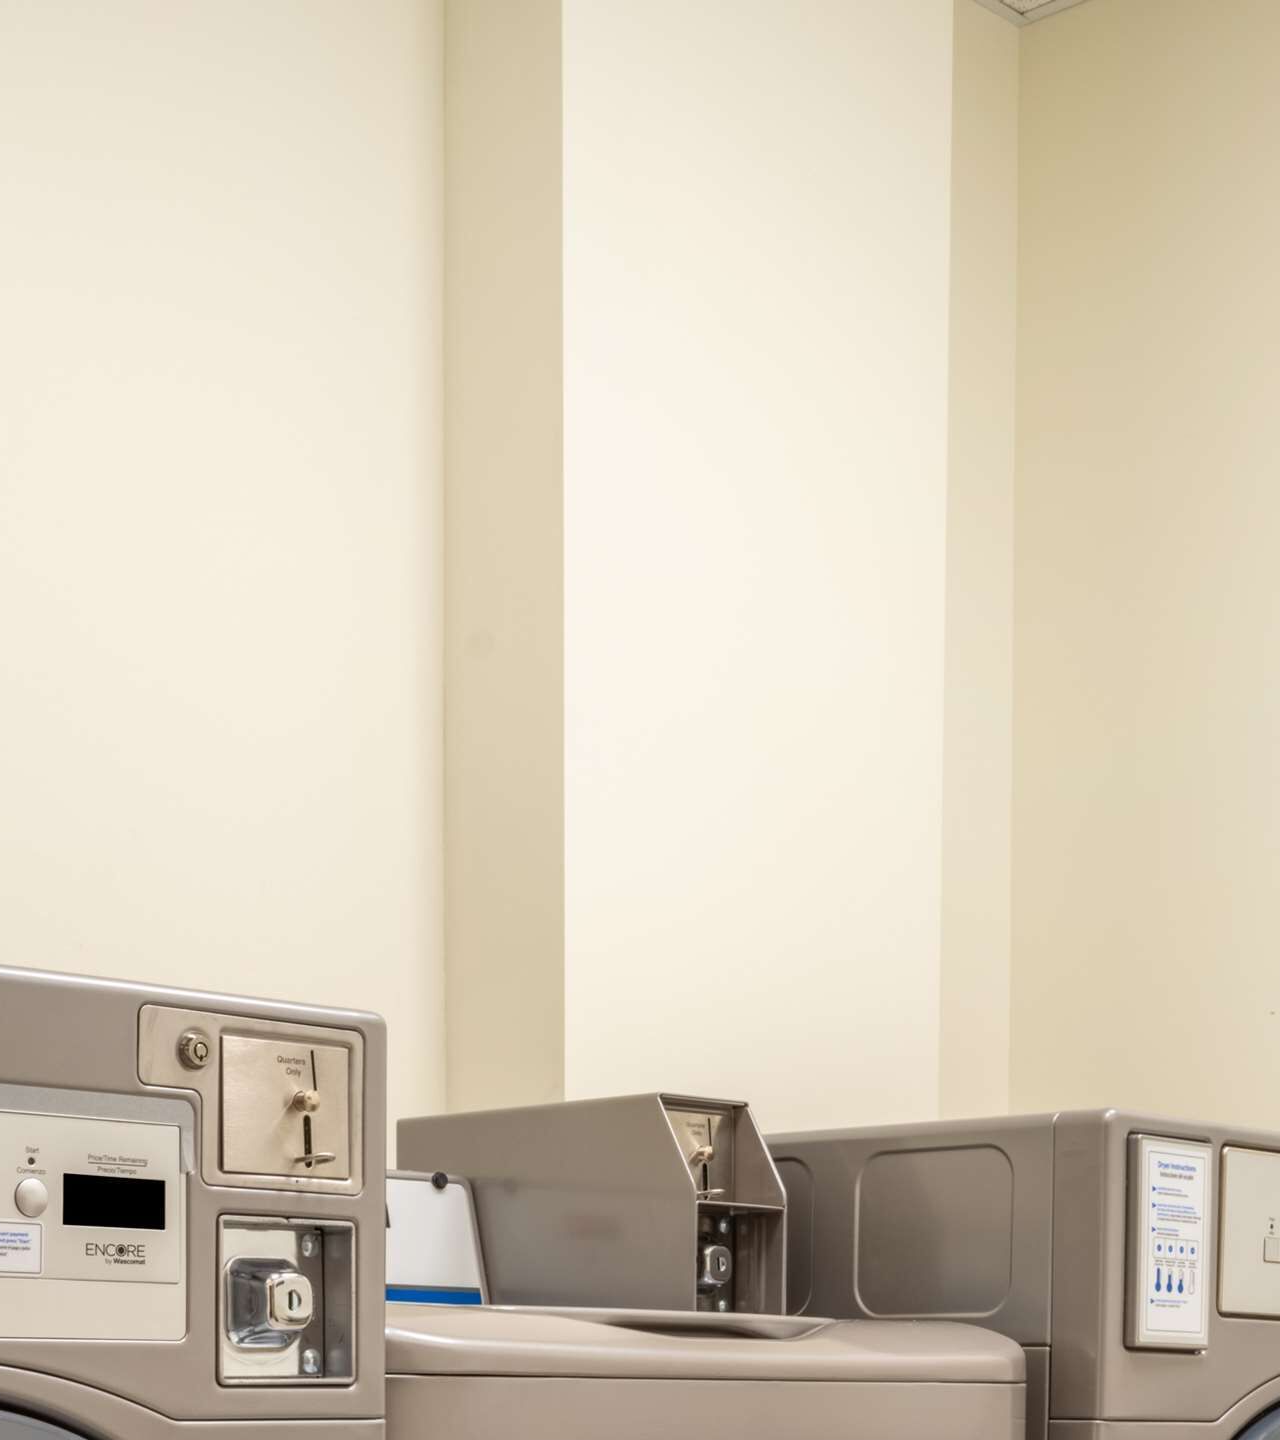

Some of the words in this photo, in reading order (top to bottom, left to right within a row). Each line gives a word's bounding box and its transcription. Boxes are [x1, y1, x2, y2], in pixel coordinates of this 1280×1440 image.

[277, 1055, 305, 1066] Quarters
[286, 1067, 302, 1077] Only
[25, 1146, 39, 1154] Start
[86, 1243, 146, 1258] ENCORE
